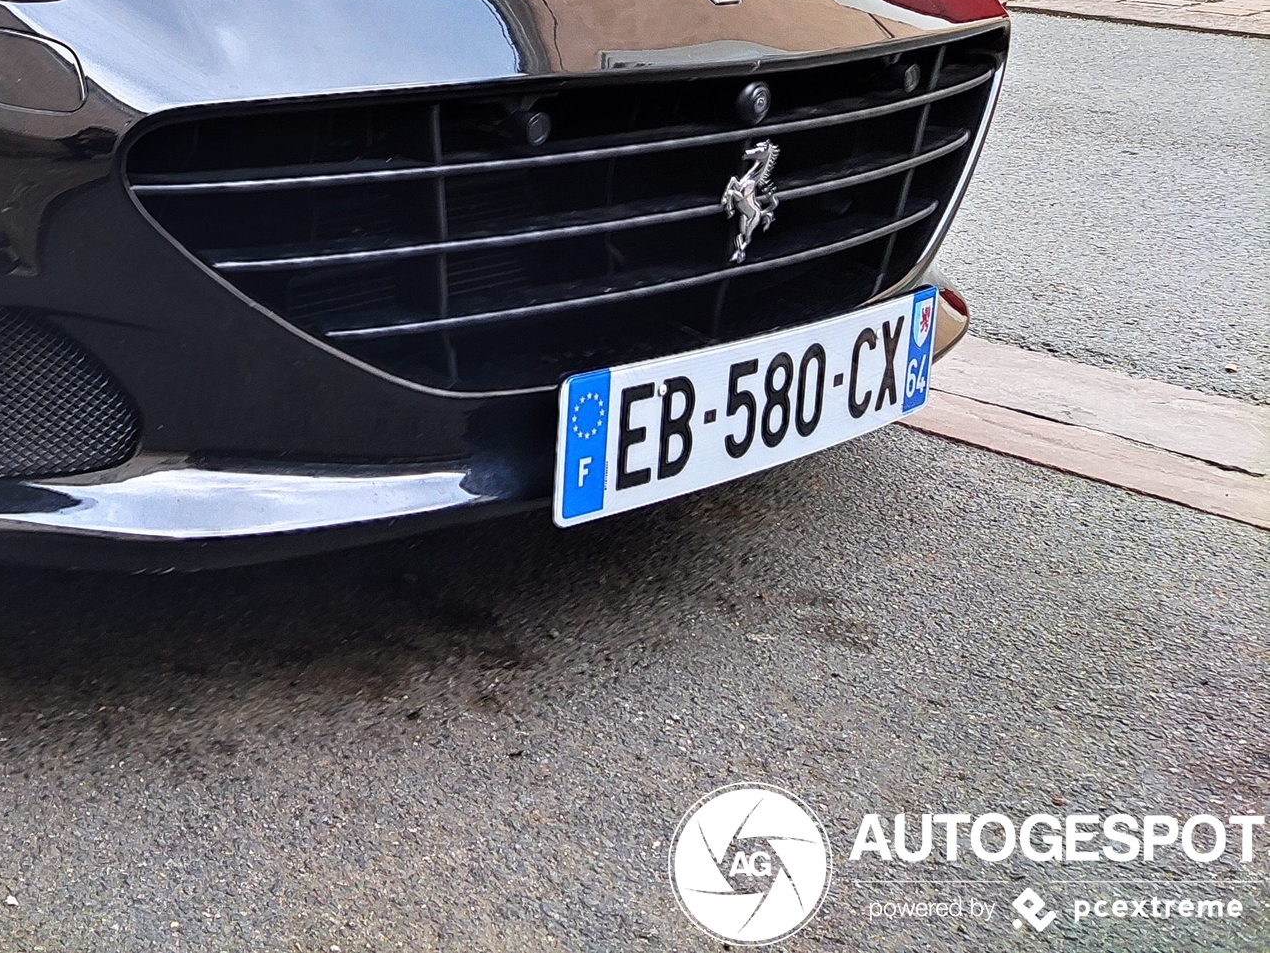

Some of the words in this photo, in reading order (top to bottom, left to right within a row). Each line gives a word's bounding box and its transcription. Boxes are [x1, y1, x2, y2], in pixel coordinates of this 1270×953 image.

[905, 354, 927, 398] 64
[616, 315, 905, 491] EB-580-CX
[578, 456, 592, 488] F
